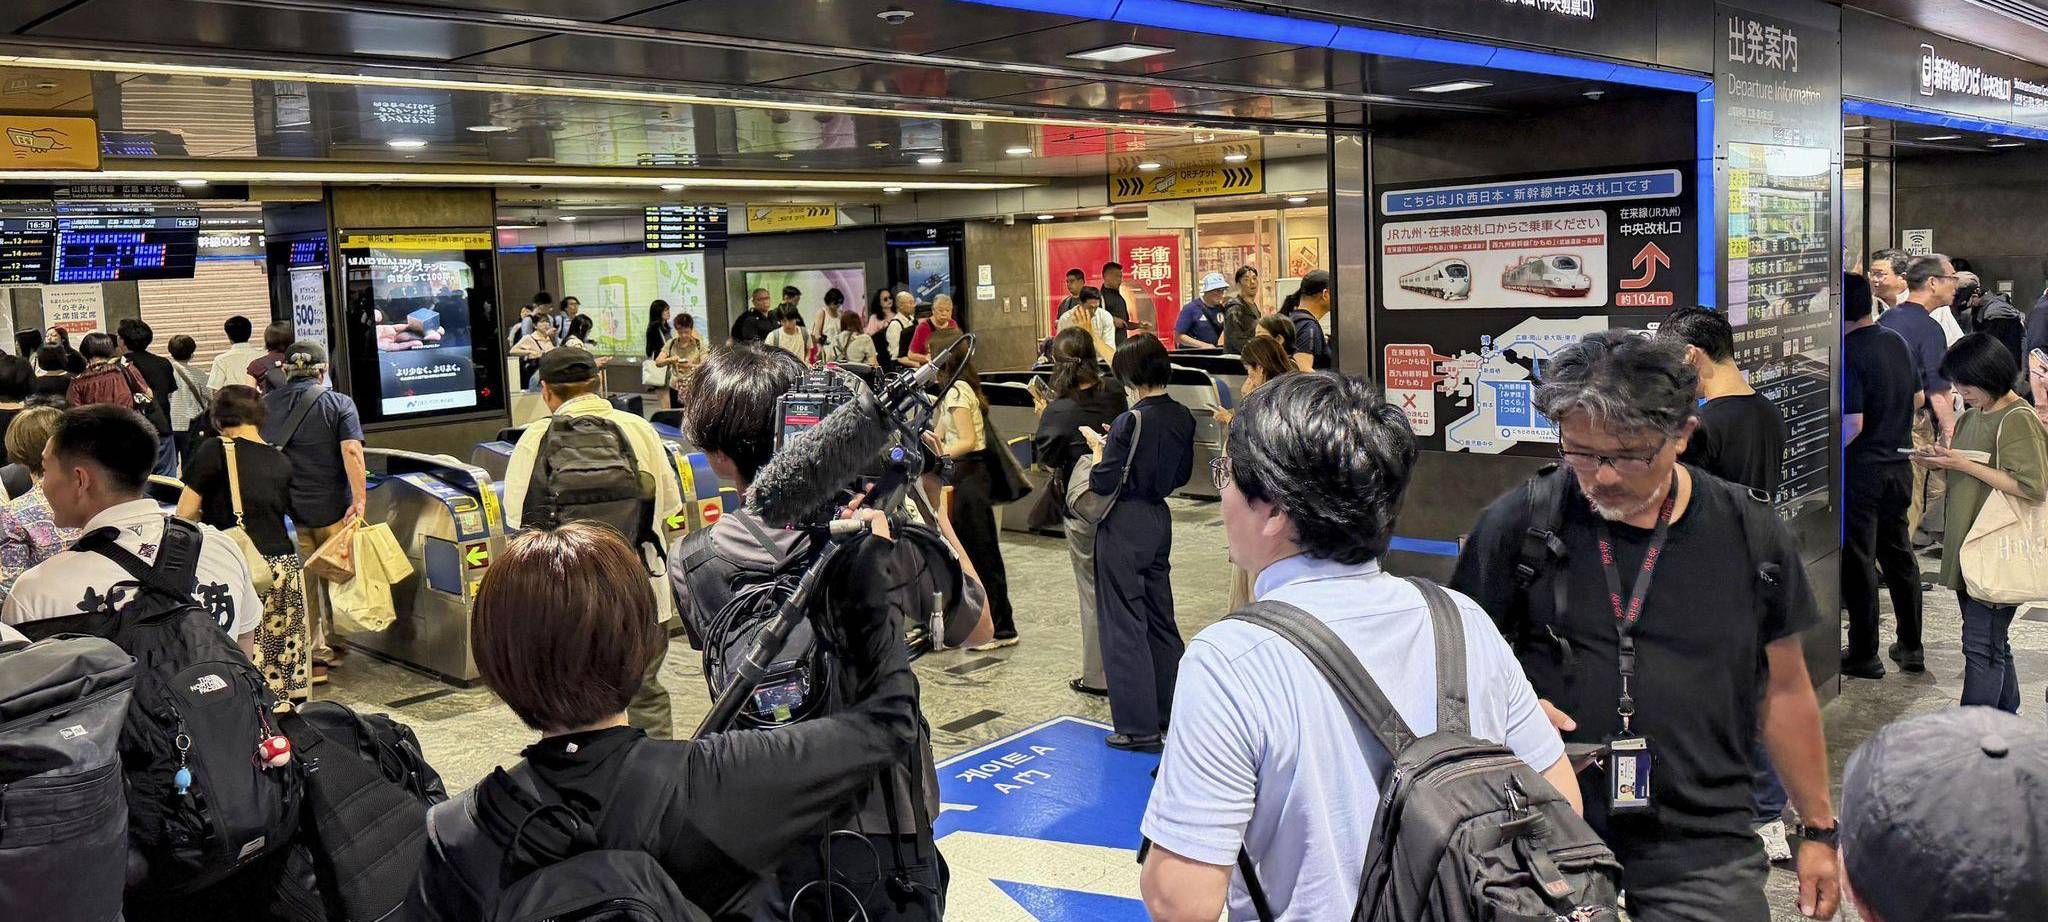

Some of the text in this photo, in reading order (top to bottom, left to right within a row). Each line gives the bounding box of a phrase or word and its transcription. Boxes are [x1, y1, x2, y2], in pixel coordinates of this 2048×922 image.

[1728, 16, 1798, 73] 出発案内
[1728, 73, 1821, 106] Departure Information
[1181, 168, 1217, 179] QRチケット
[1403, 178, 1652, 208] こちらはJR西日本・新幹線中央改札口です
[1620, 206, 1681, 219] 在来線(JR九州)
[178, 219, 197, 227] 16:58
[1386, 217, 1600, 240] JR九州・在来線改札口からご乗車ください
[1620, 221, 1682, 237] 中央改札口
[12, 237, 22, 245] 12
[1130, 246, 1152, 287] 幸福。
[1151, 246, 1174, 301] 衝動と、
[1620, 293, 1669, 305] 約104m
[295, 304, 314, 326] 500
[1388, 357, 1430, 365] 「リレーかもめ」
[1389, 369, 1429, 378] 西九州新幹線
[1394, 379, 1424, 387] 「かもめ」
[1500, 399, 1526, 407] 「さくら」
[1500, 406, 1526, 415] 「つばめ」
